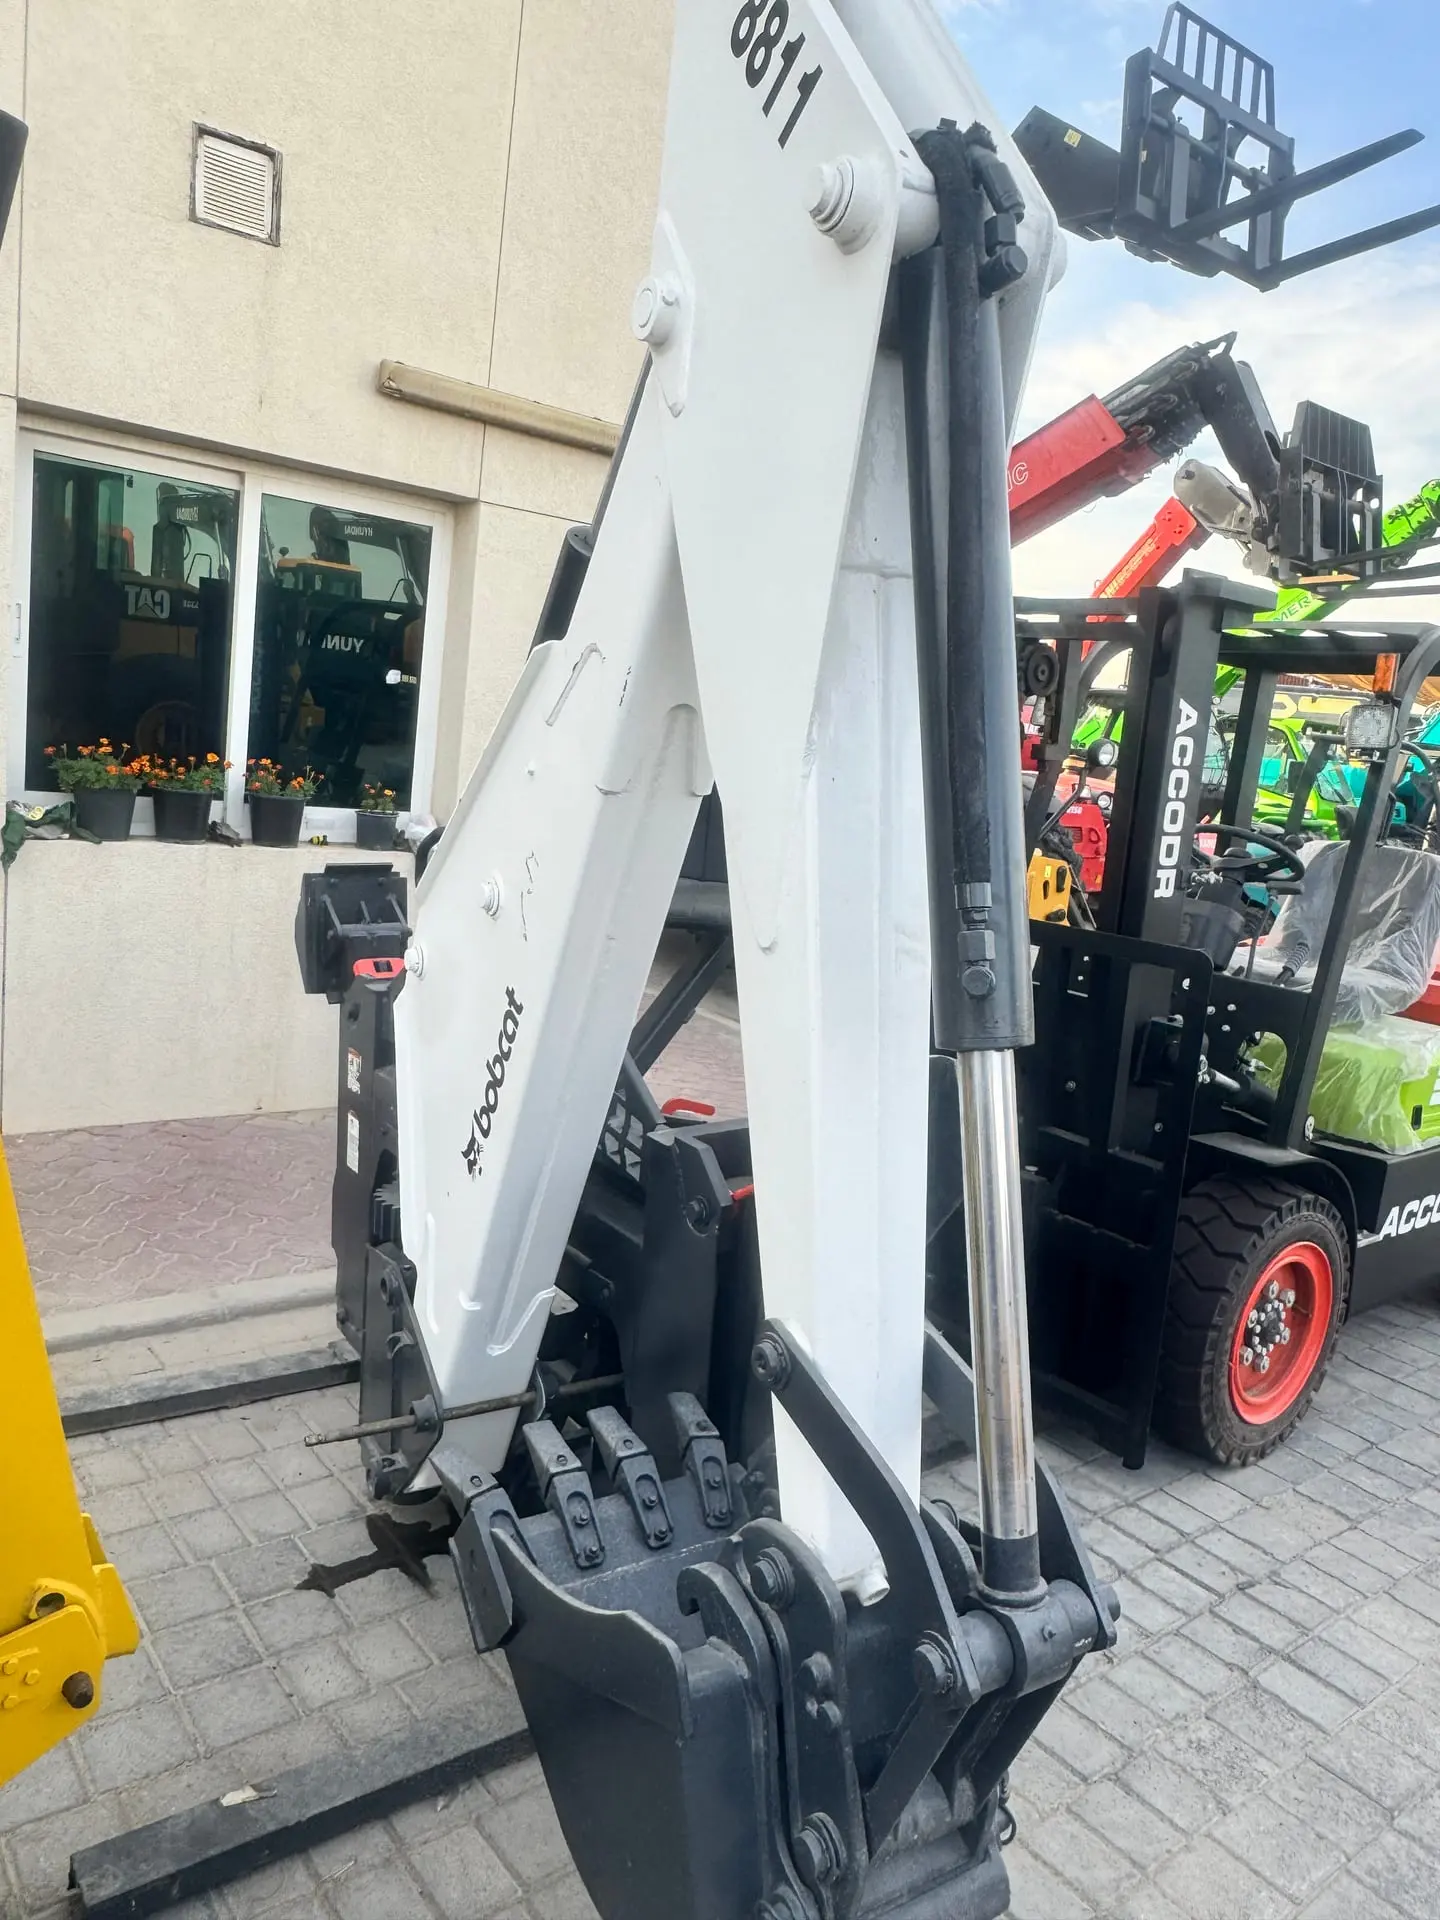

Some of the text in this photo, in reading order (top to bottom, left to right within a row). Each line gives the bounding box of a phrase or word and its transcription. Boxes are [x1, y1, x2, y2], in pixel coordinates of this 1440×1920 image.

[730, 0, 823, 150] 8811
[1153, 698, 1198, 898] ACCODR
[474, 986, 524, 1139] bobcat
